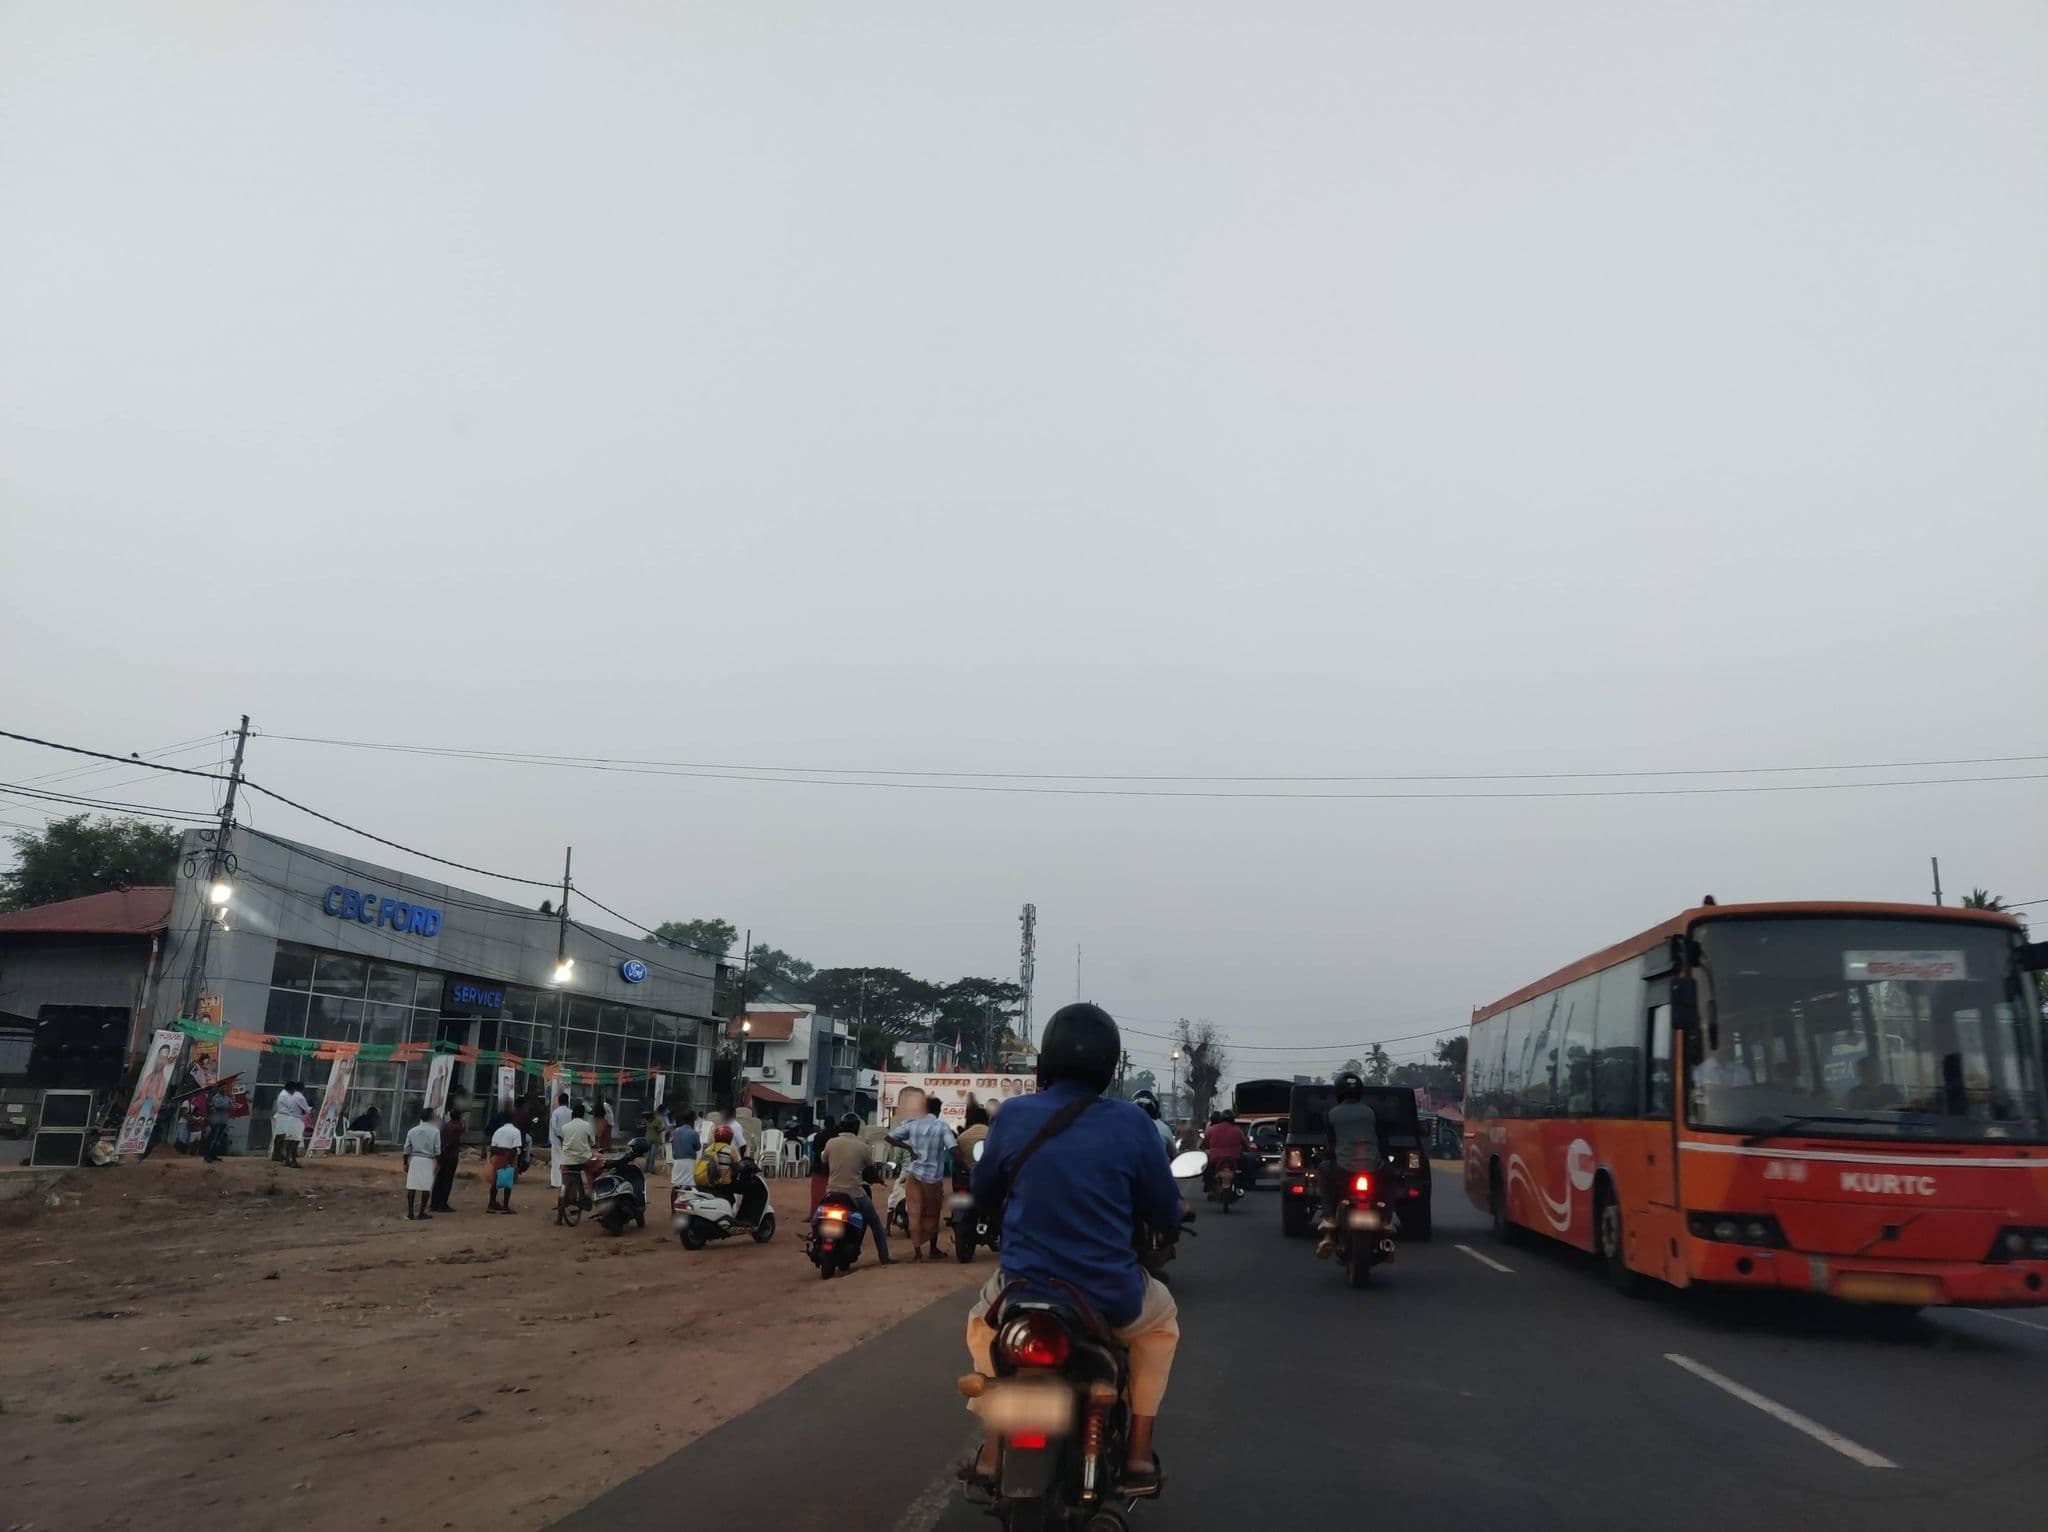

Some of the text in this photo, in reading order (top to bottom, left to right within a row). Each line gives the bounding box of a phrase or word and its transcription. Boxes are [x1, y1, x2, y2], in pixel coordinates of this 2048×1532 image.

[324, 886, 441, 937] CBC FORD
[453, 985, 502, 1008] SERVICE
[1840, 1172, 1937, 1196] KURTC
